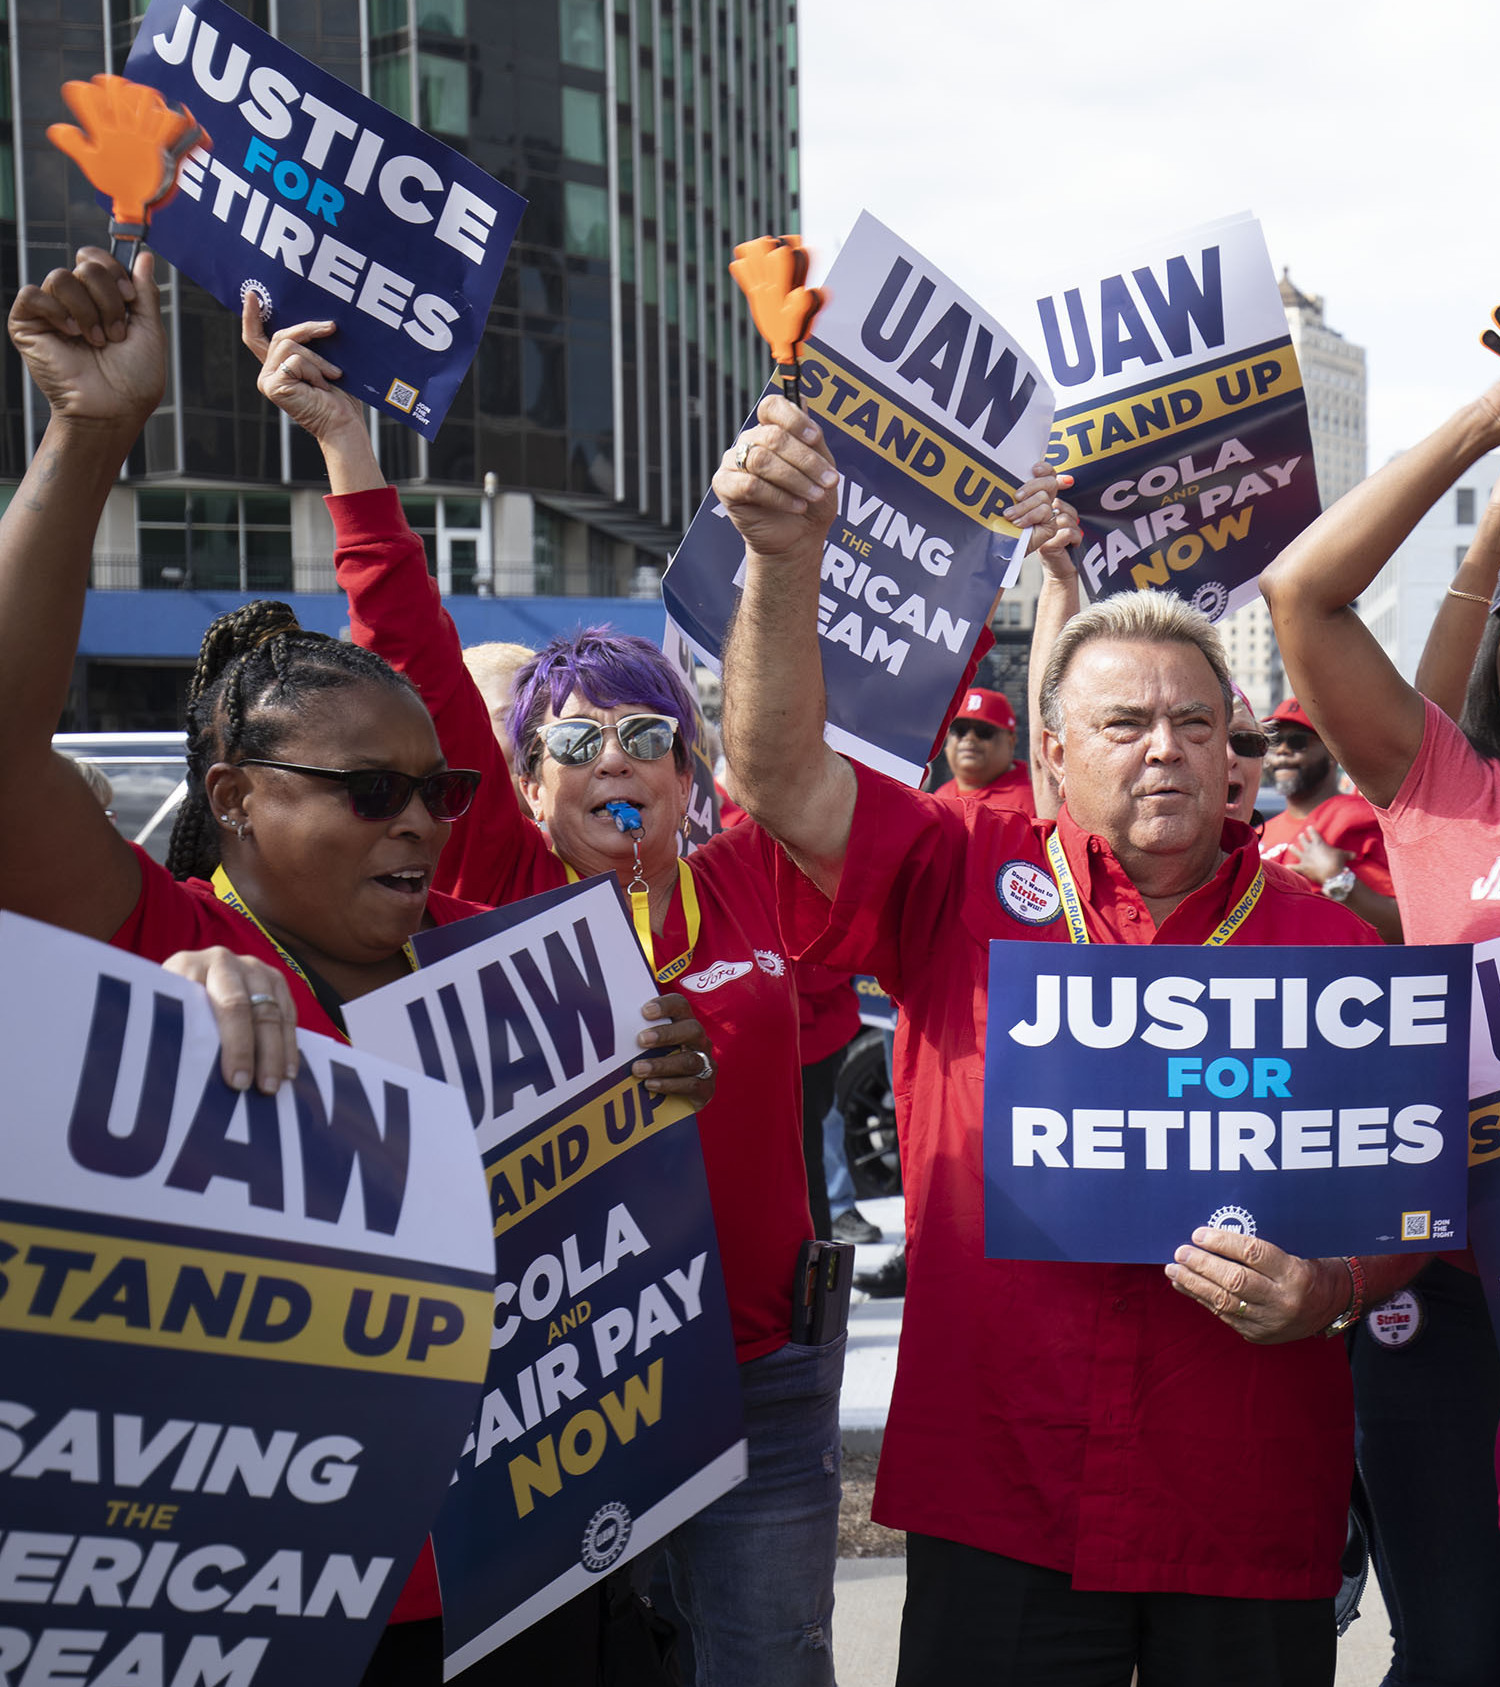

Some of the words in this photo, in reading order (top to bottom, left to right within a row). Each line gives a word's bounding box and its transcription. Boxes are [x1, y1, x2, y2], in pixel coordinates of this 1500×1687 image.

[153, 4, 498, 265] JUSTICE
[243, 136, 346, 227] FOR
[176, 145, 461, 353] ETIREES
[860, 256, 1037, 450] UAW
[1037, 245, 1225, 387] UAW
[412, 412, 430, 425] FIGHT
[415, 406, 427, 417] THE
[417, 402, 431, 413] JOIN
[799, 360, 948, 483] STAND
[953, 465, 1017, 519] UP
[1045, 388, 1202, 466] STAND
[1217, 360, 1282, 413] UP
[1100, 438, 1255, 511] COLA
[1161, 484, 1200, 508] AND
[837, 472, 955, 577] VING
[841, 528, 873, 558] THE
[1083, 501, 1189, 594] FAIR
[1199, 456, 1302, 523] PAY
[1130, 506, 1255, 592] NOW
[1010, 880, 1047, 907] Strike
[1010, 891, 1022, 901] But
[1011, 870, 1028, 885] Don't
[1028, 882, 1045, 895] Want
[1031, 873, 1038, 882] I
[1054, 856, 1068, 880] THE
[1062, 882, 1086, 944] AMERICAN
[1212, 936, 1223, 944] A
[1219, 896, 1253, 935] STRONG
[657, 957, 687, 981] NITED
[697, 964, 737, 989] Ford
[405, 917, 615, 1130] UAW
[1008, 974, 1448, 1049] JUSTICE
[67, 973, 411, 1236] UAW
[1167, 1057, 1293, 1098] FOR
[489, 1124, 590, 1229] AND
[603, 1081, 667, 1146] UP
[1012, 1104, 1444, 1171] RETIREES
[489, 1202, 651, 1350] COLA
[342, 1288, 465, 1362] UP
[547, 1300, 592, 1346] AND
[592, 1251, 708, 1380] PAY
[1377, 1312, 1410, 1326] Strike
[508, 1358, 664, 1519] NOW
[105, 1501, 179, 1531] THE
[0, 1531, 395, 1619] ERICAN
